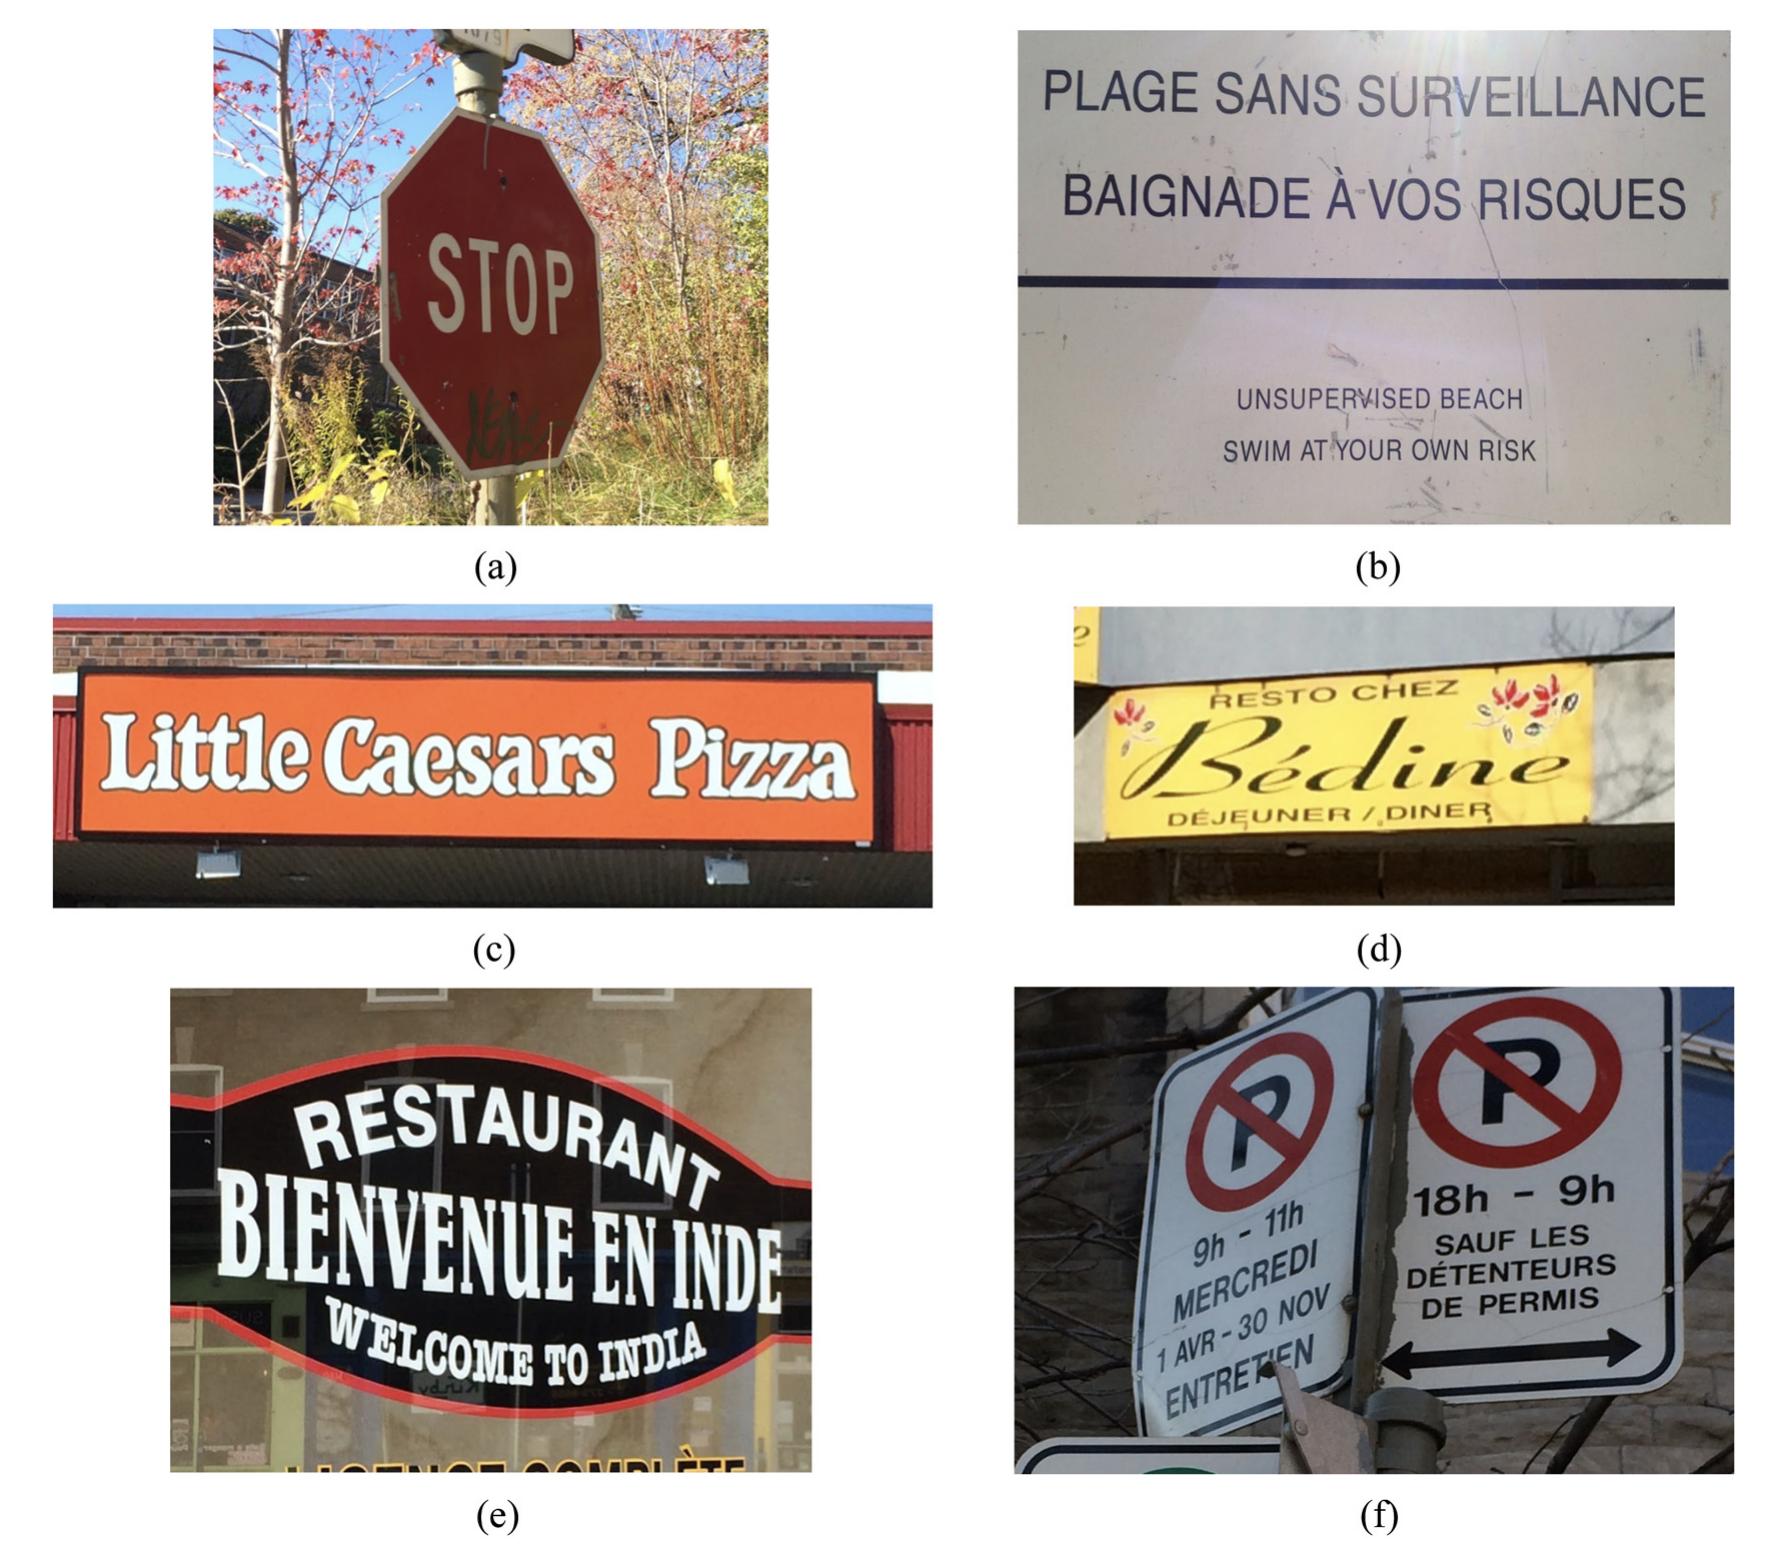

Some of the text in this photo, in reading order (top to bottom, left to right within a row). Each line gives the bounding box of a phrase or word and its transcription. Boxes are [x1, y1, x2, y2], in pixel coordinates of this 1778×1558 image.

[1044, 69, 1707, 119] PLAGE SANS SURVEILLANCE
[1064, 166, 1687, 223] BAIGNADE À VOS RISQUES
[427, 232, 574, 336] STOP
[1237, 387, 1523, 411] UNSUPERVISED BEACH
[1223, 438, 1537, 463] SWIM AT YOUR OWN RISK
[1210, 679, 1459, 710] RESTO CHEZ
[100, 714, 856, 800] Little Caesars Pizza
[1120, 714, 1571, 800] Bédine
[1167, 807, 1351, 827] DÉJEUNER
[1386, 801, 1493, 821] DINER
[293, 1083, 721, 1212] RESTAURANT
[1413, 1183, 1488, 1218] 18h
[1559, 1173, 1615, 1206] 9h
[216, 1167, 782, 1315] BIENVENUE EN INDE
[1193, 1232, 1225, 1268] 9h
[1265, 1199, 1304, 1238] 11h
[1434, 1224, 1590, 1257] SAUF LES
[1173, 1238, 1318, 1325] MERCREDI
[1406, 1253, 1617, 1290] DÉTENTEURS
[1157, 1347, 1166, 1374] 1
[1174, 1328, 1216, 1367] AVR
[1237, 1307, 1268, 1341] 30
[1279, 1282, 1331, 1325] NOV
[1421, 1286, 1599, 1320] DE PERMIS
[324, 1295, 707, 1387] WELCOME TO INDIA
